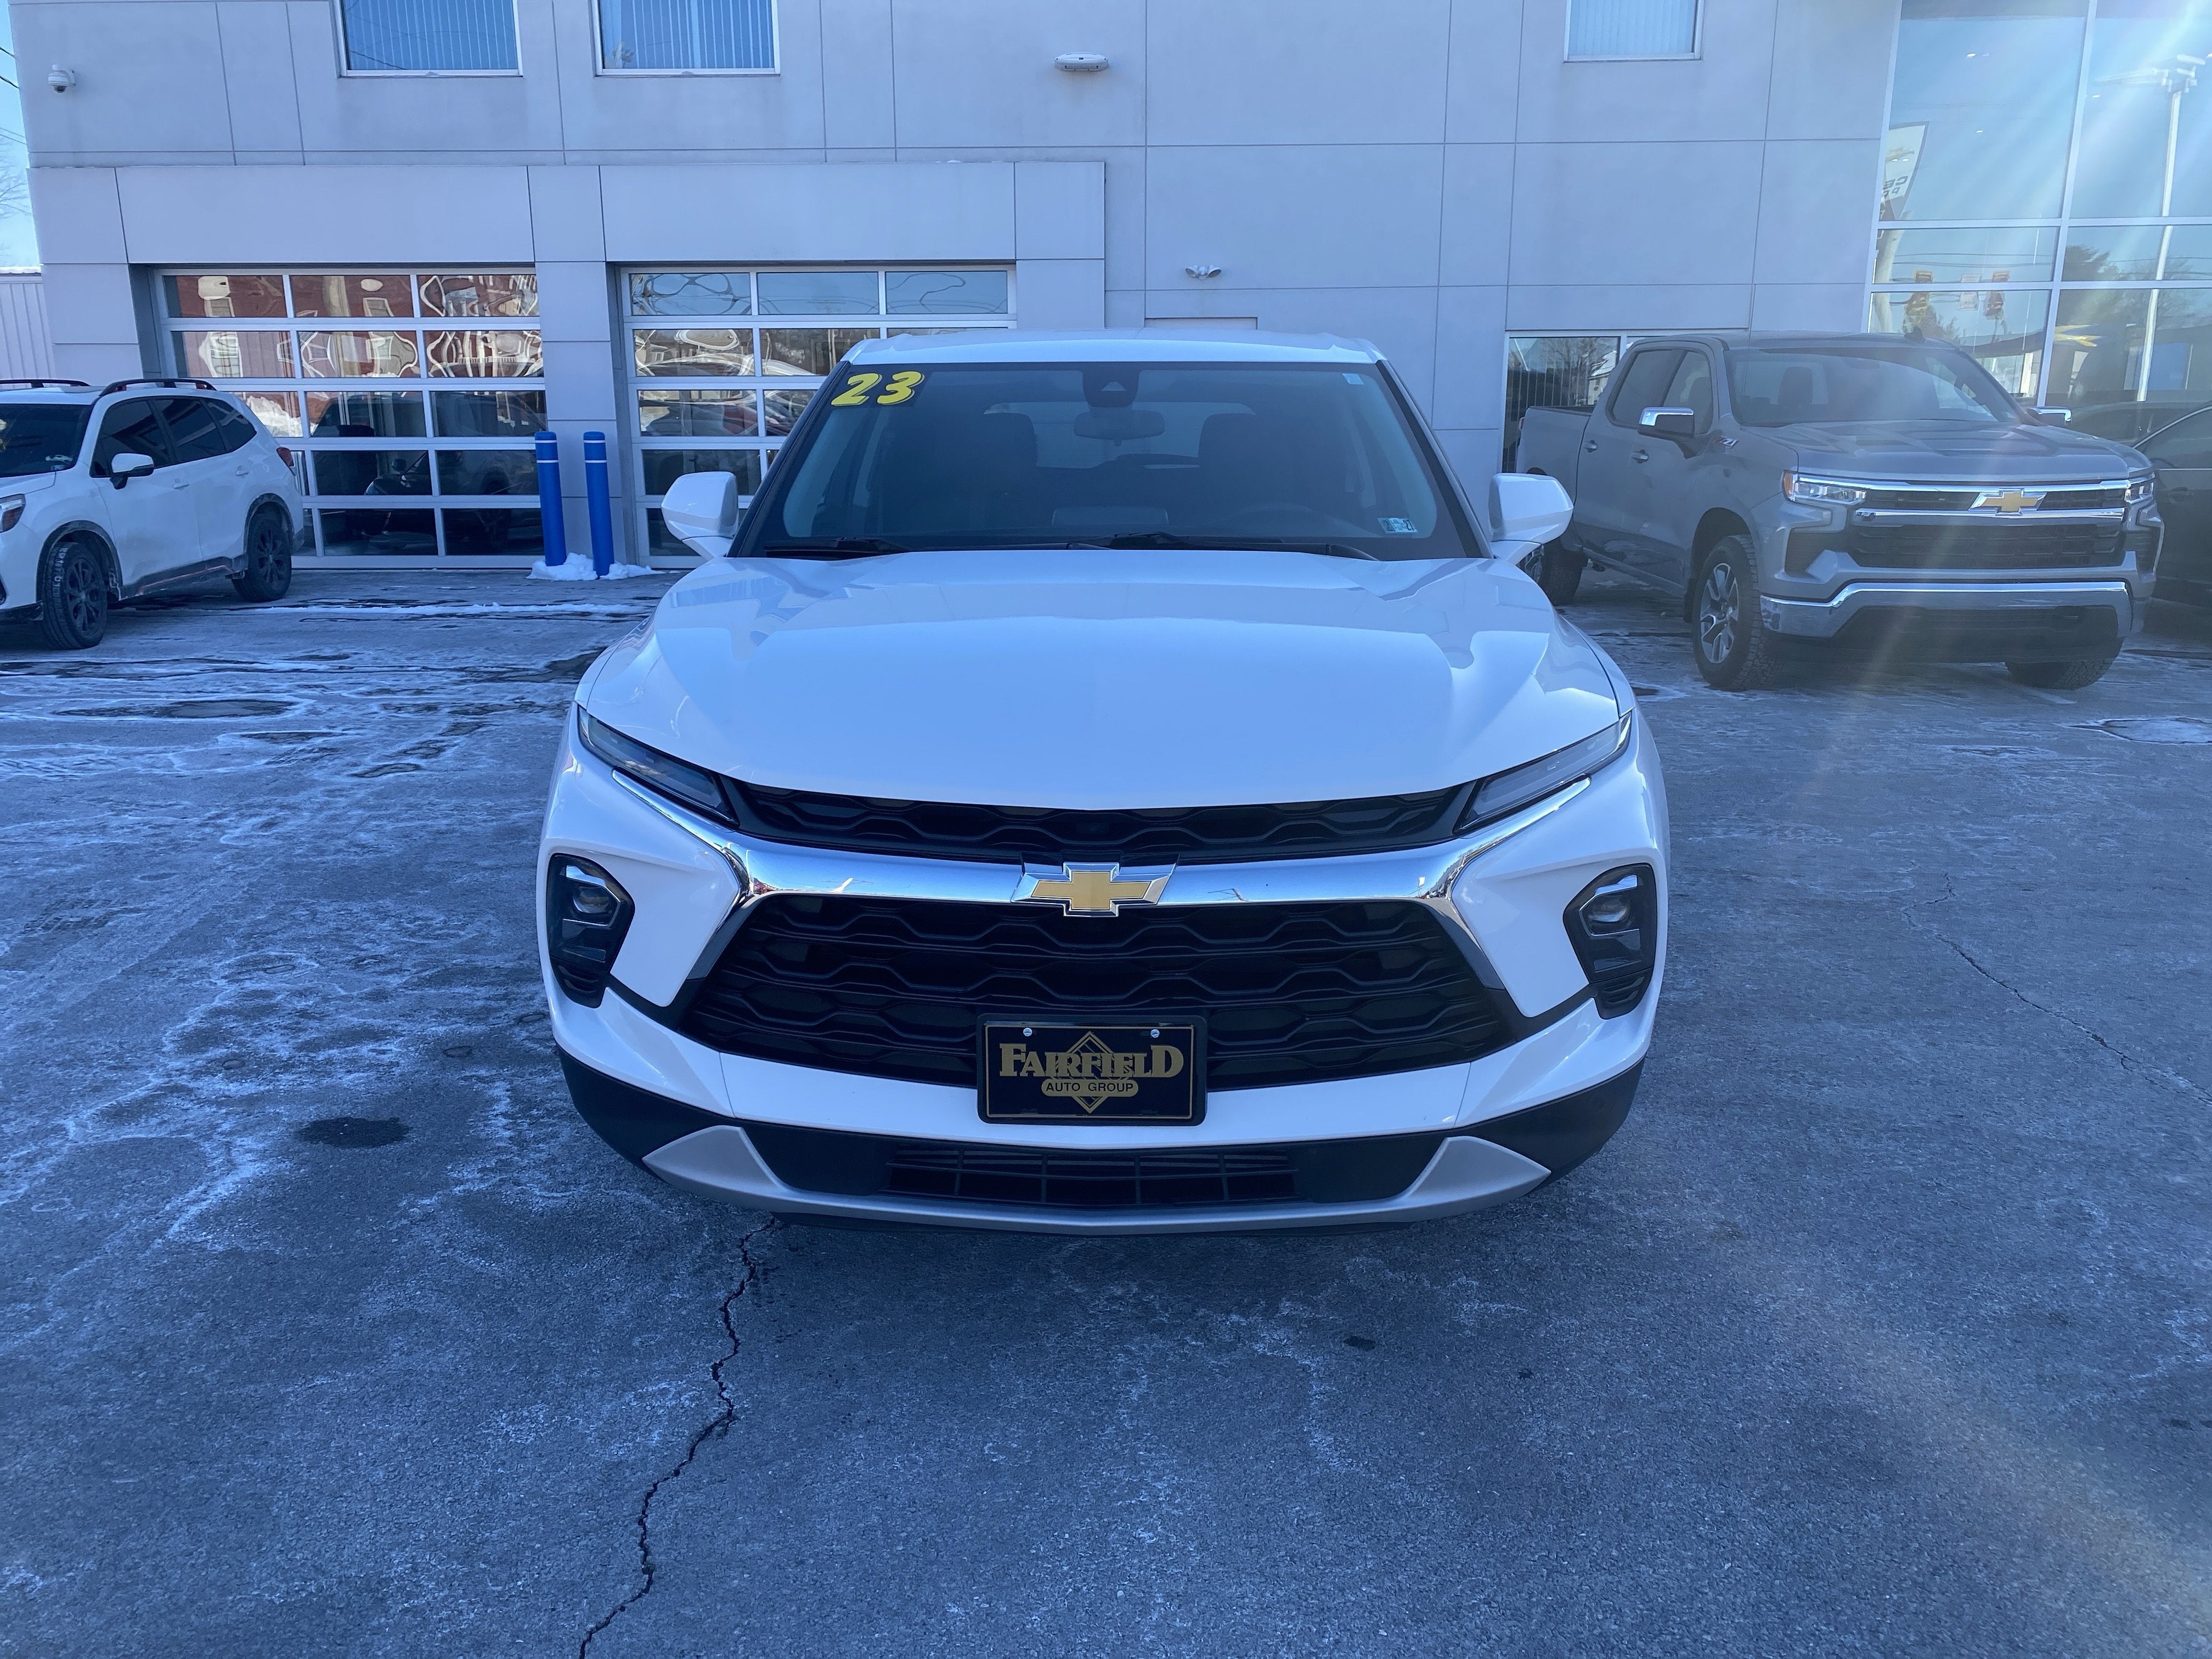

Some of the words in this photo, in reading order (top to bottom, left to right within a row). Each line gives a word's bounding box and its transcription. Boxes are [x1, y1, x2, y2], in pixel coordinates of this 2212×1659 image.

[831, 371, 925, 406] 23
[999, 1043, 1184, 1078] FAIRFIELD
[1046, 1082, 1081, 1092] AUTO
[1088, 1082, 1134, 1092] GROUP
